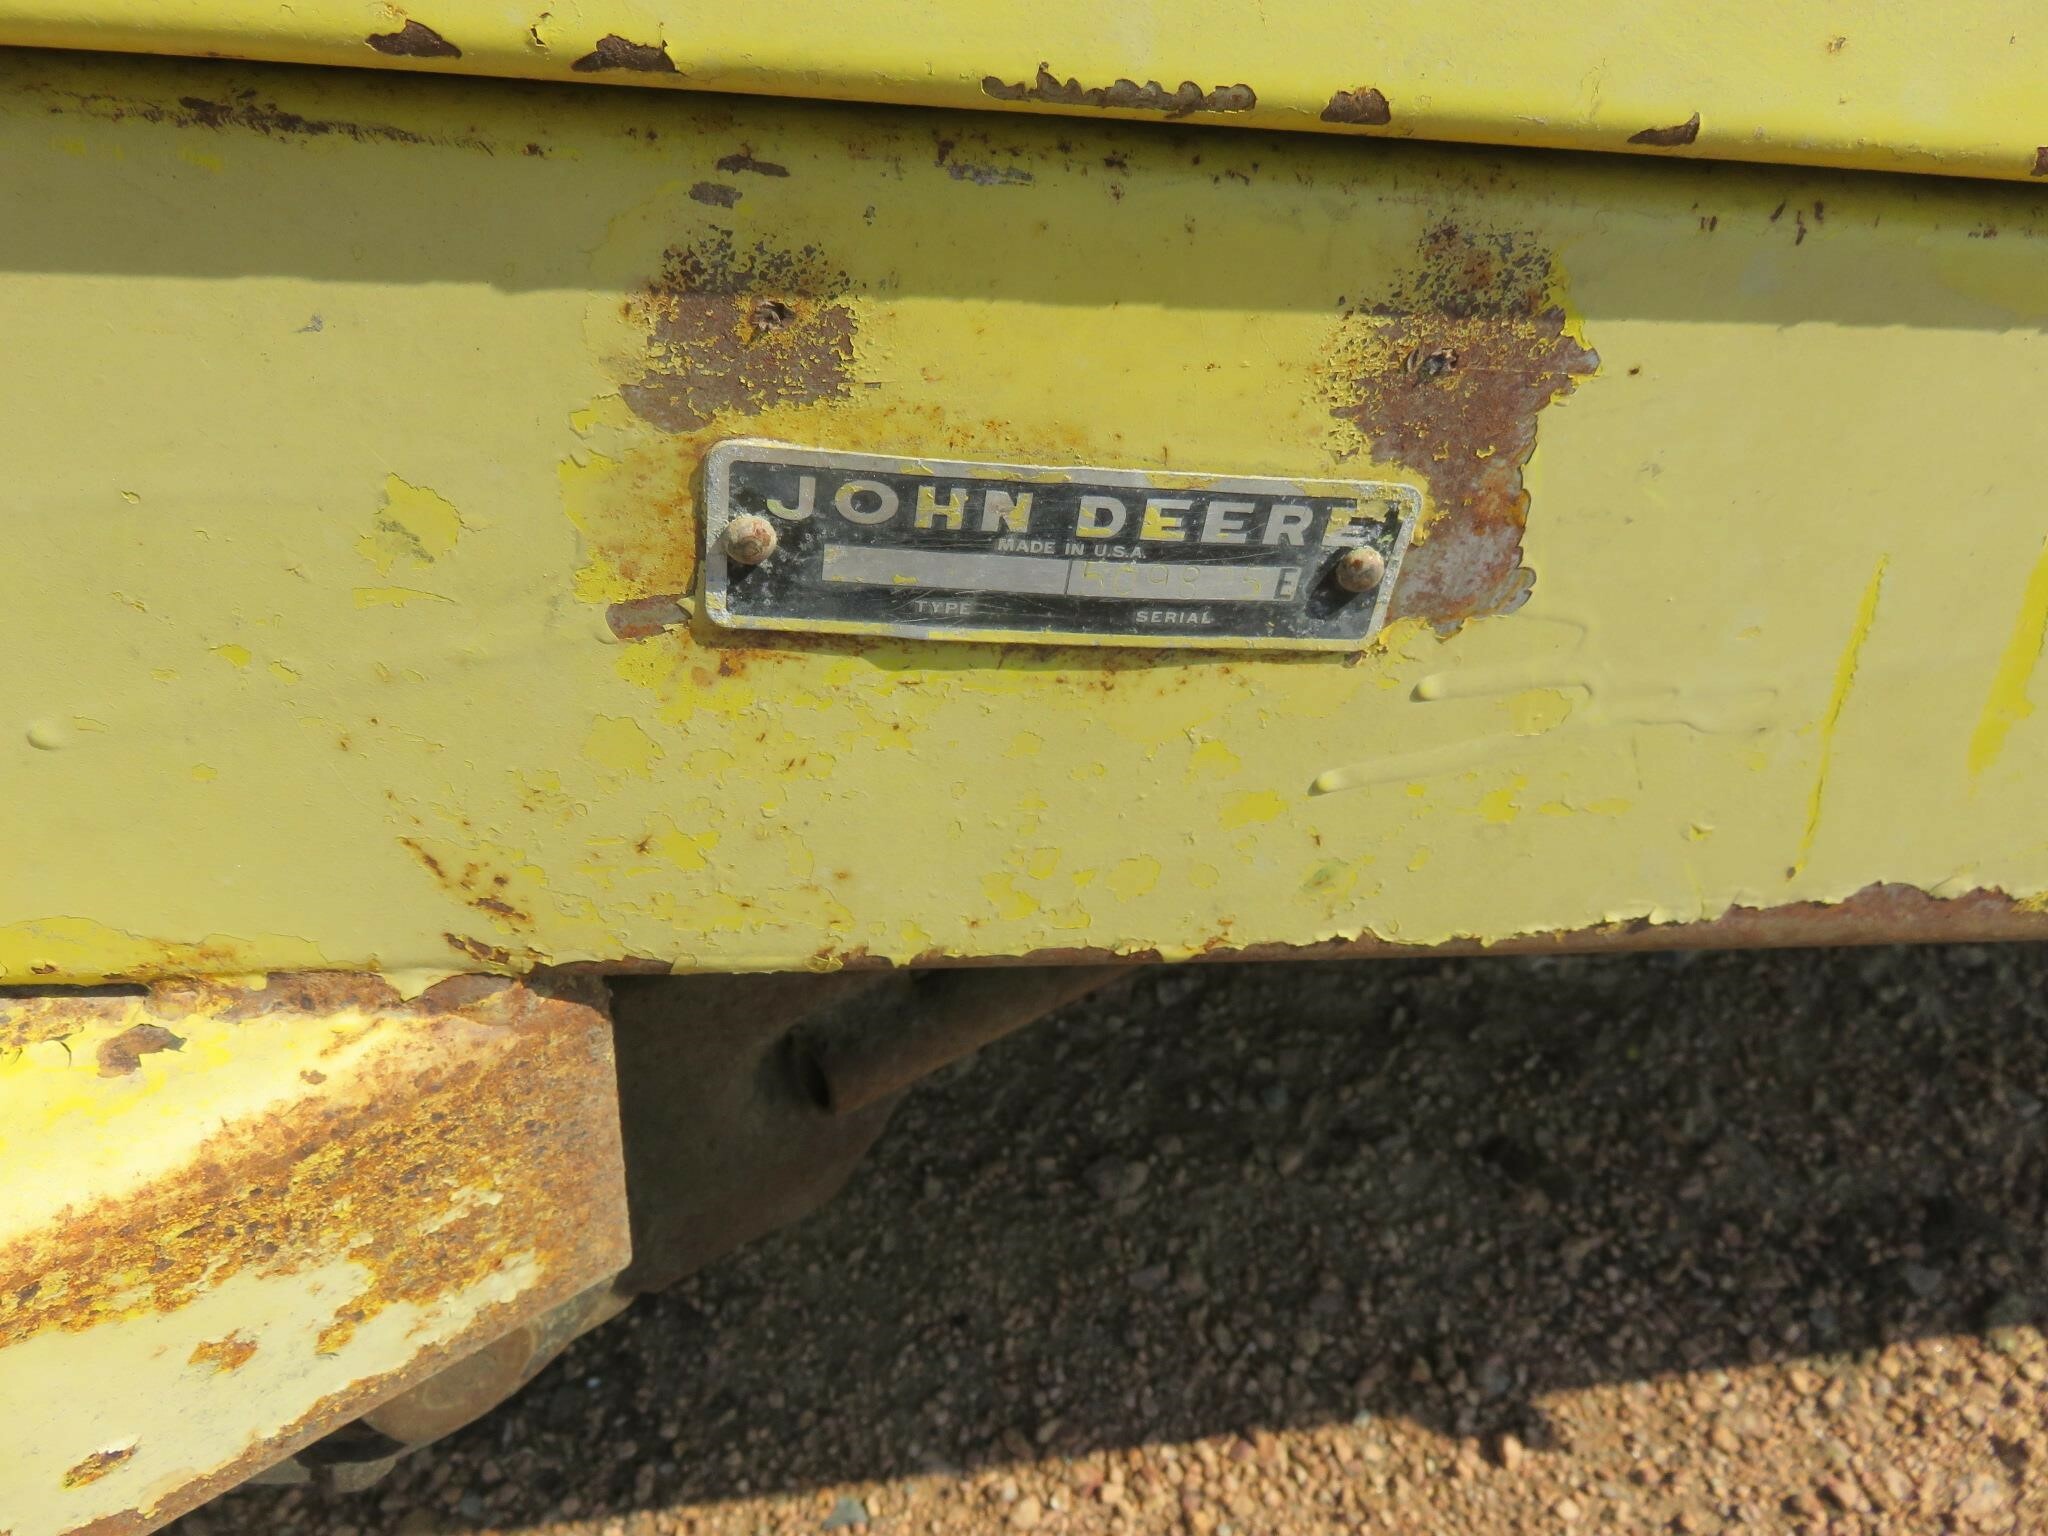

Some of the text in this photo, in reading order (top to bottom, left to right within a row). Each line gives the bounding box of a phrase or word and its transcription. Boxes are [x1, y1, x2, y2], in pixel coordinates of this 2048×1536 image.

[766, 475, 1381, 548] JOHN DEERE
[998, 538, 1147, 560] MADE IN U.S.A.
[914, 599, 1213, 625] TYPE SERIAL
